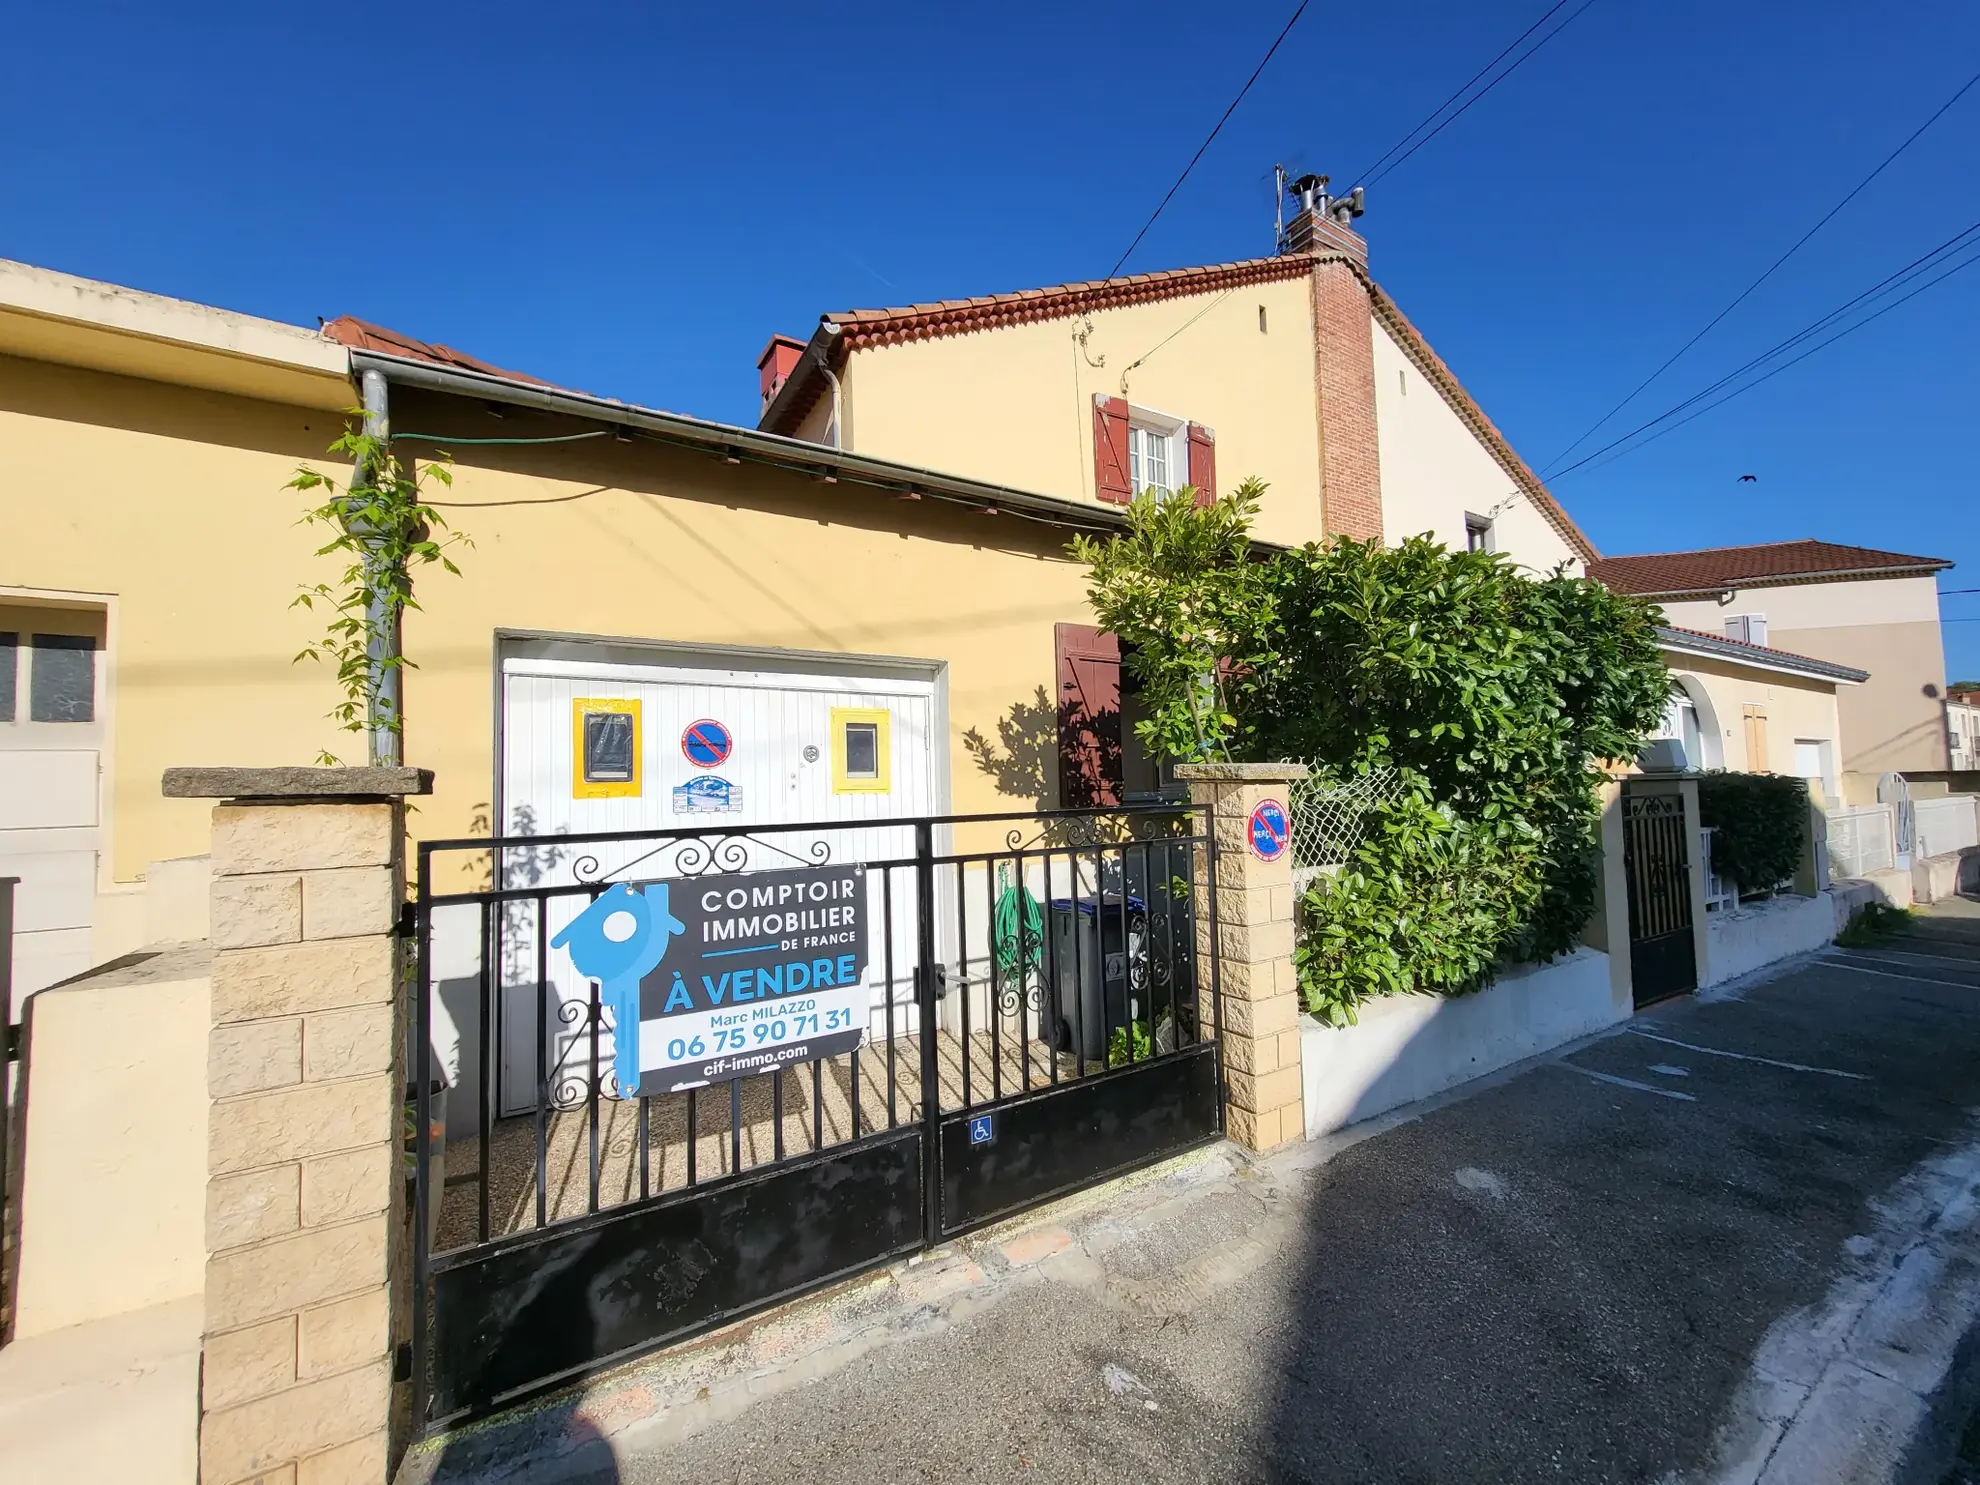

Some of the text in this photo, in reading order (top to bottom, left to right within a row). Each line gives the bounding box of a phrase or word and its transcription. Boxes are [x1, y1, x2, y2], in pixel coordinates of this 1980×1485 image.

[701, 879, 855, 913] COMPTOIR
[703, 906, 856, 942] IMMOBILIER
[781, 931, 856, 951] DE FRANCE
[663, 954, 857, 1013] À VENDRE
[711, 999, 816, 1028] Marc MILAZZO
[667, 1007, 851, 1061] 06 75 90 71 31
[703, 1045, 808, 1076] cif-immo.com
